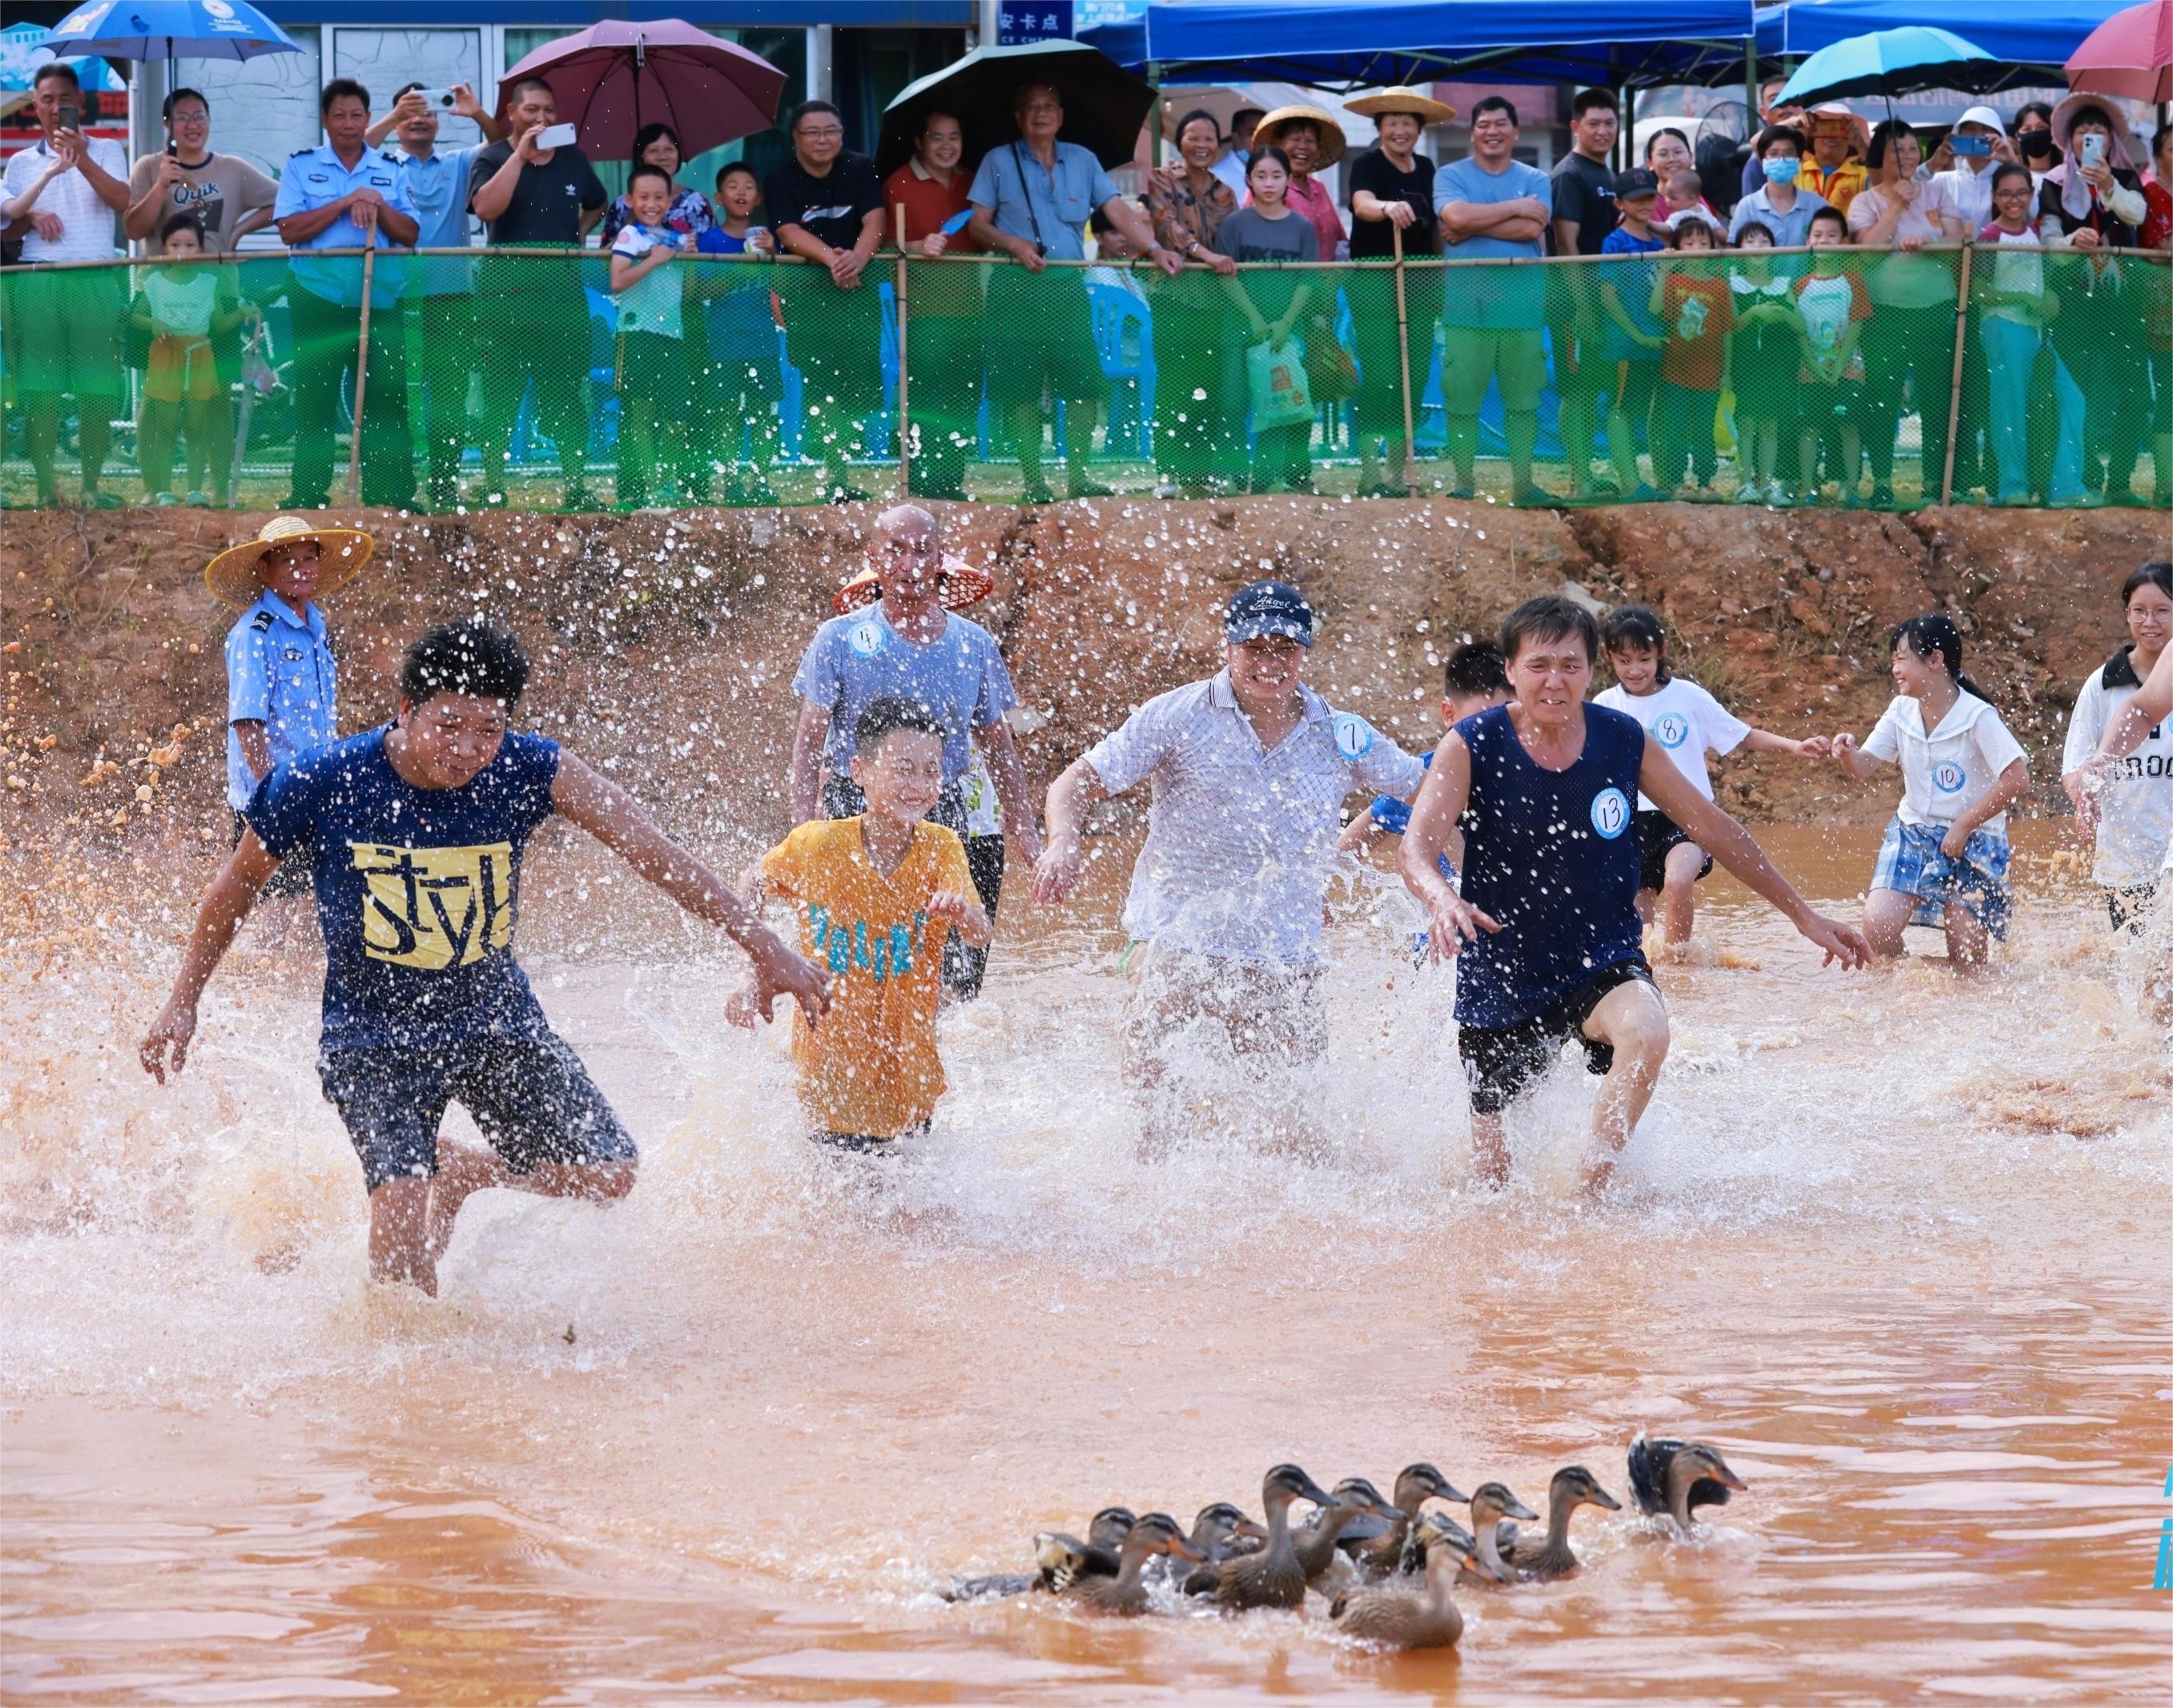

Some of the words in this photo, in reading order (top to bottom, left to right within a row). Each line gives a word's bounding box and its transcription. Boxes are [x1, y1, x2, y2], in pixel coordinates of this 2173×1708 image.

[1254, 595, 1290, 609] Angel
[1663, 718, 1676, 740] 8
[1941, 769, 1954, 786] 10
[1603, 798, 1620, 830] 13
